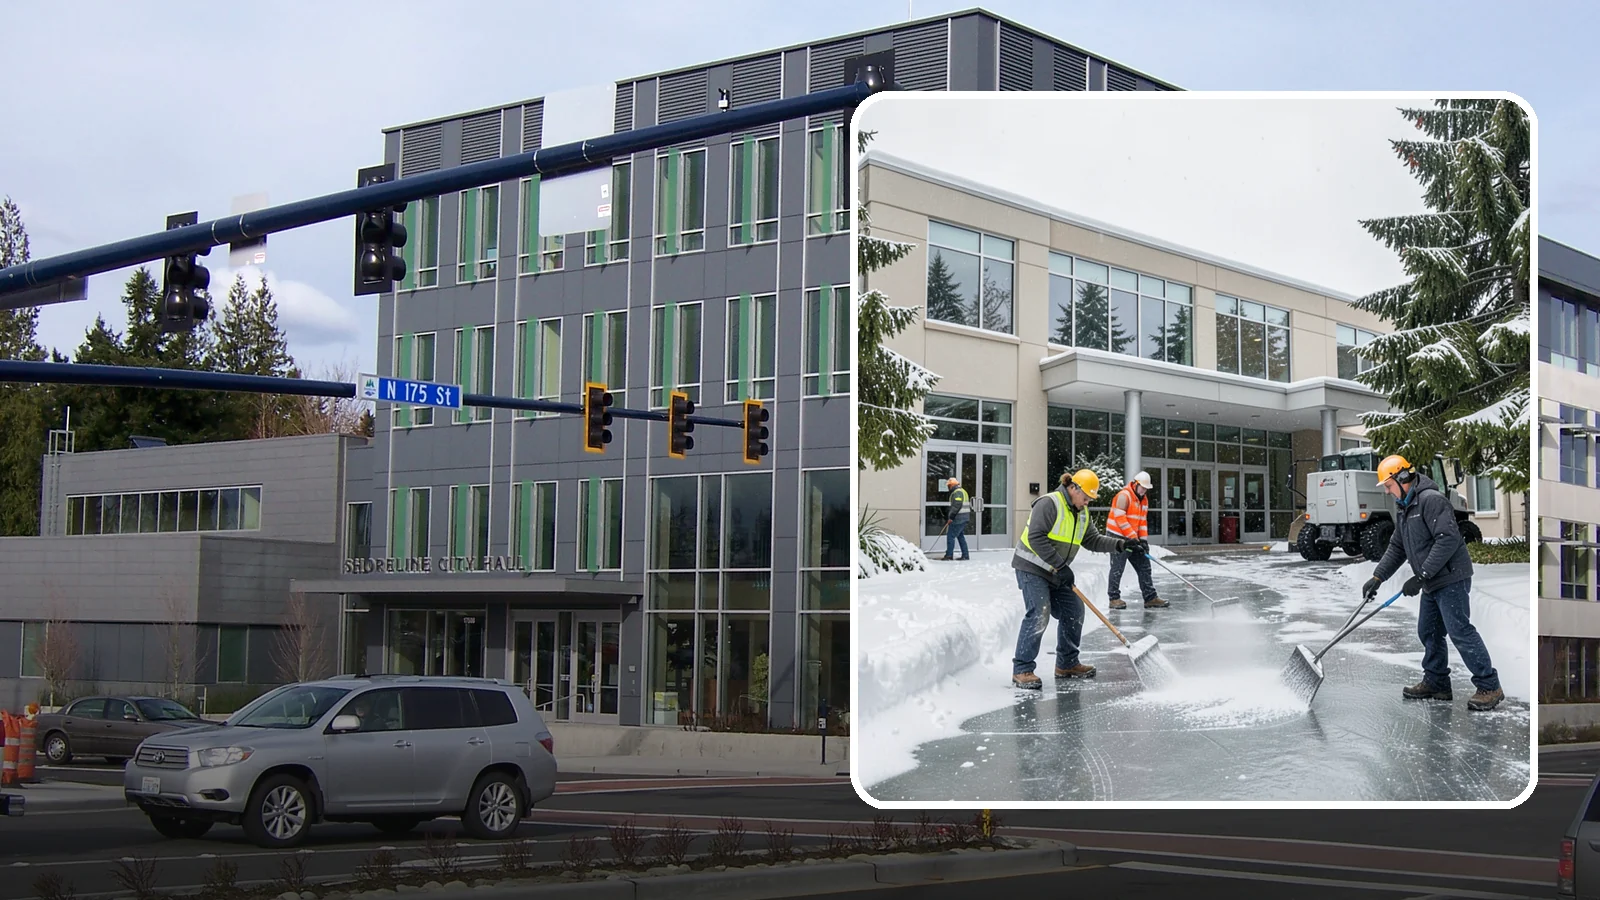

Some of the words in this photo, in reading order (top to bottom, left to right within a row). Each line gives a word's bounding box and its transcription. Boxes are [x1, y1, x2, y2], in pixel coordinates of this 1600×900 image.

[387, 380, 396, 400] N
[405, 382, 427, 403] 175
[436, 386, 451, 406] St
[344, 556, 432, 574] SHORELINE
[438, 556, 476, 571] CITY
[483, 555, 526, 571] HALL
